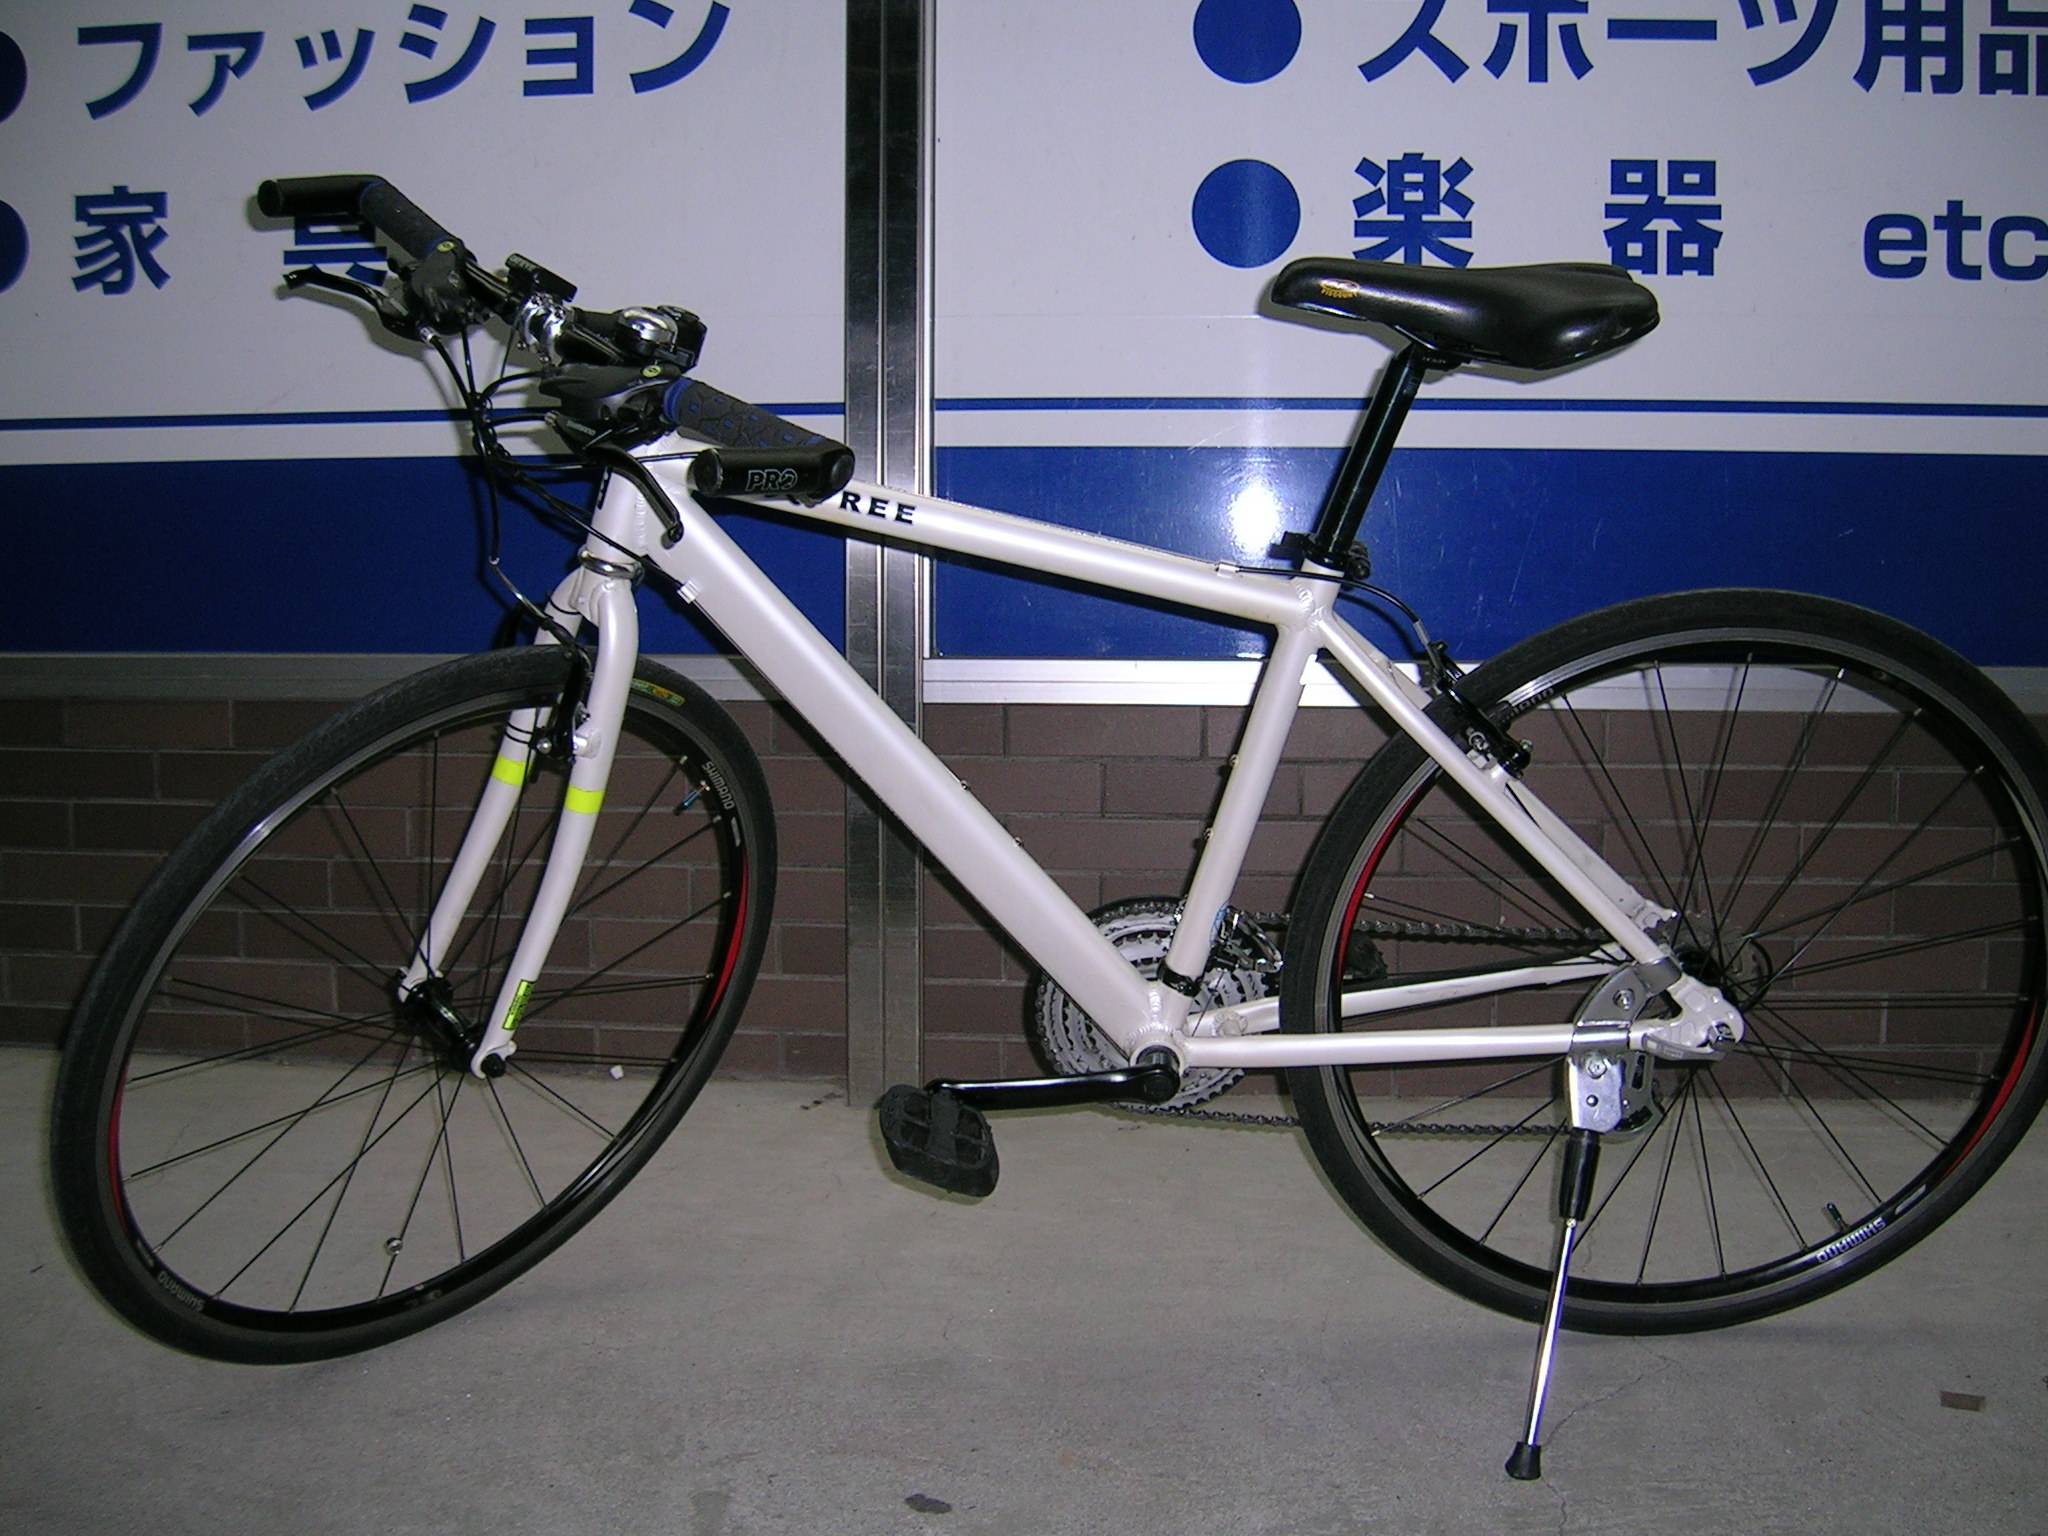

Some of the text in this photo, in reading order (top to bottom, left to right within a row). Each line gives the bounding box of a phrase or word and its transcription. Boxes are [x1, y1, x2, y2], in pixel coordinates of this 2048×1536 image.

[77, 0, 730, 120] ファッション
[1864, 200, 2048, 281] etc
[745, 468, 798, 492] PRO
[702, 760, 736, 811] SHIMANO
[1815, 1216, 1887, 1265] SHIMANO
